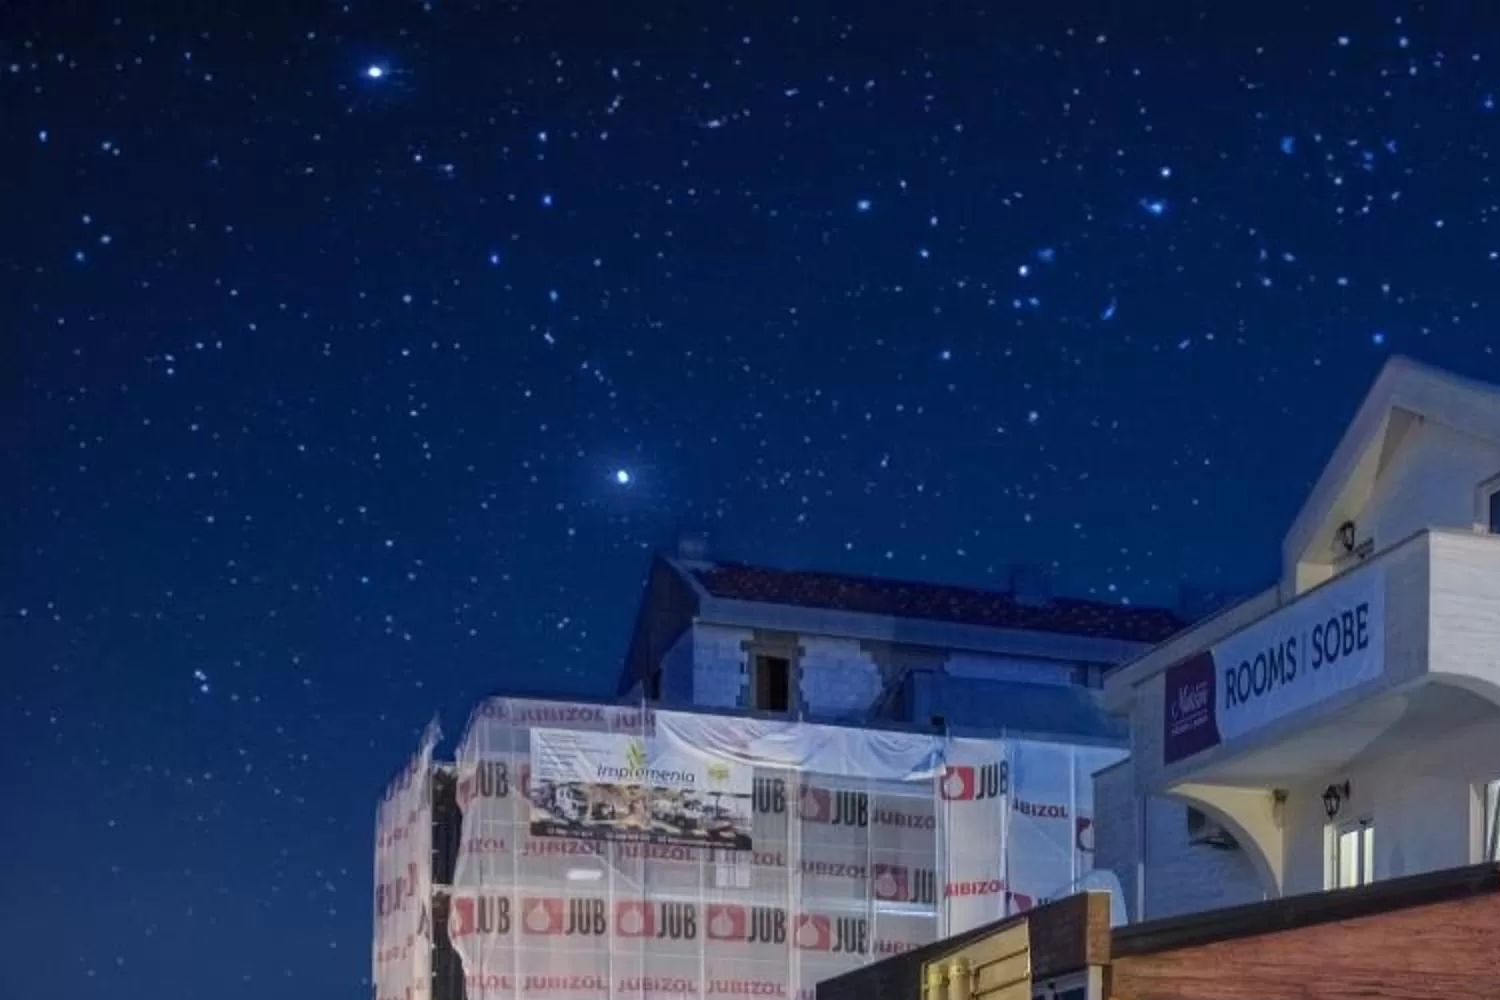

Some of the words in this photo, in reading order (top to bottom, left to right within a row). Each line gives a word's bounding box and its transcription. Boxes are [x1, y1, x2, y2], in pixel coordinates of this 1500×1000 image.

[1225, 637, 1297, 709] ROOMS
[1312, 602, 1369, 670] SOBE
[832, 791, 869, 827] JUB
[976, 760, 1008, 800] JUB
[910, 868, 937, 904] JU
[565, 897, 607, 936] JUB
[656, 903, 697, 940] JUB
[747, 906, 787, 944] JUB
